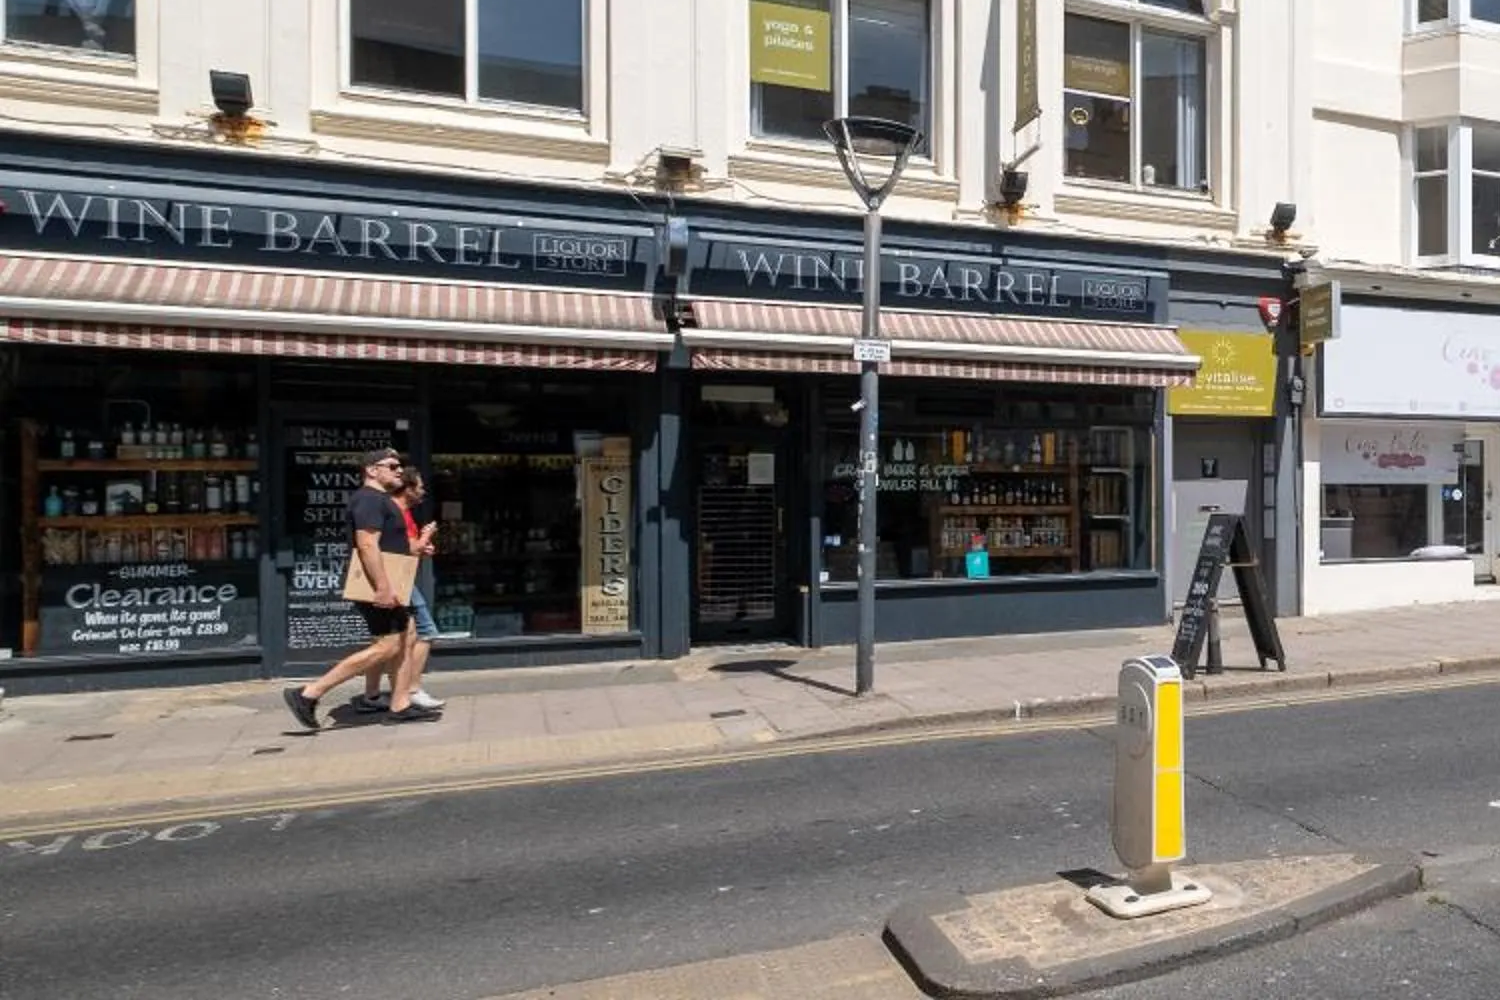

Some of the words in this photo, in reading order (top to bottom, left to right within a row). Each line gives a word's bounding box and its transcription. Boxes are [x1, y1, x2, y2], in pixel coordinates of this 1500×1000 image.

[763, 20, 799, 36] yoga
[764, 34, 814, 52] pilates
[17, 189, 233, 248] WINE
[258, 209, 520, 269] BARREL
[540, 237, 619, 260] LIQUOR
[897, 262, 1071, 308] BARREL
[1197, 370, 1256, 384] evitalise
[311, 472, 361, 487] WIN
[314, 543, 349, 557] FRE
[294, 576, 340, 589] OVER
[65, 583, 238, 609] Clearance
[85, 611, 118, 626] When
